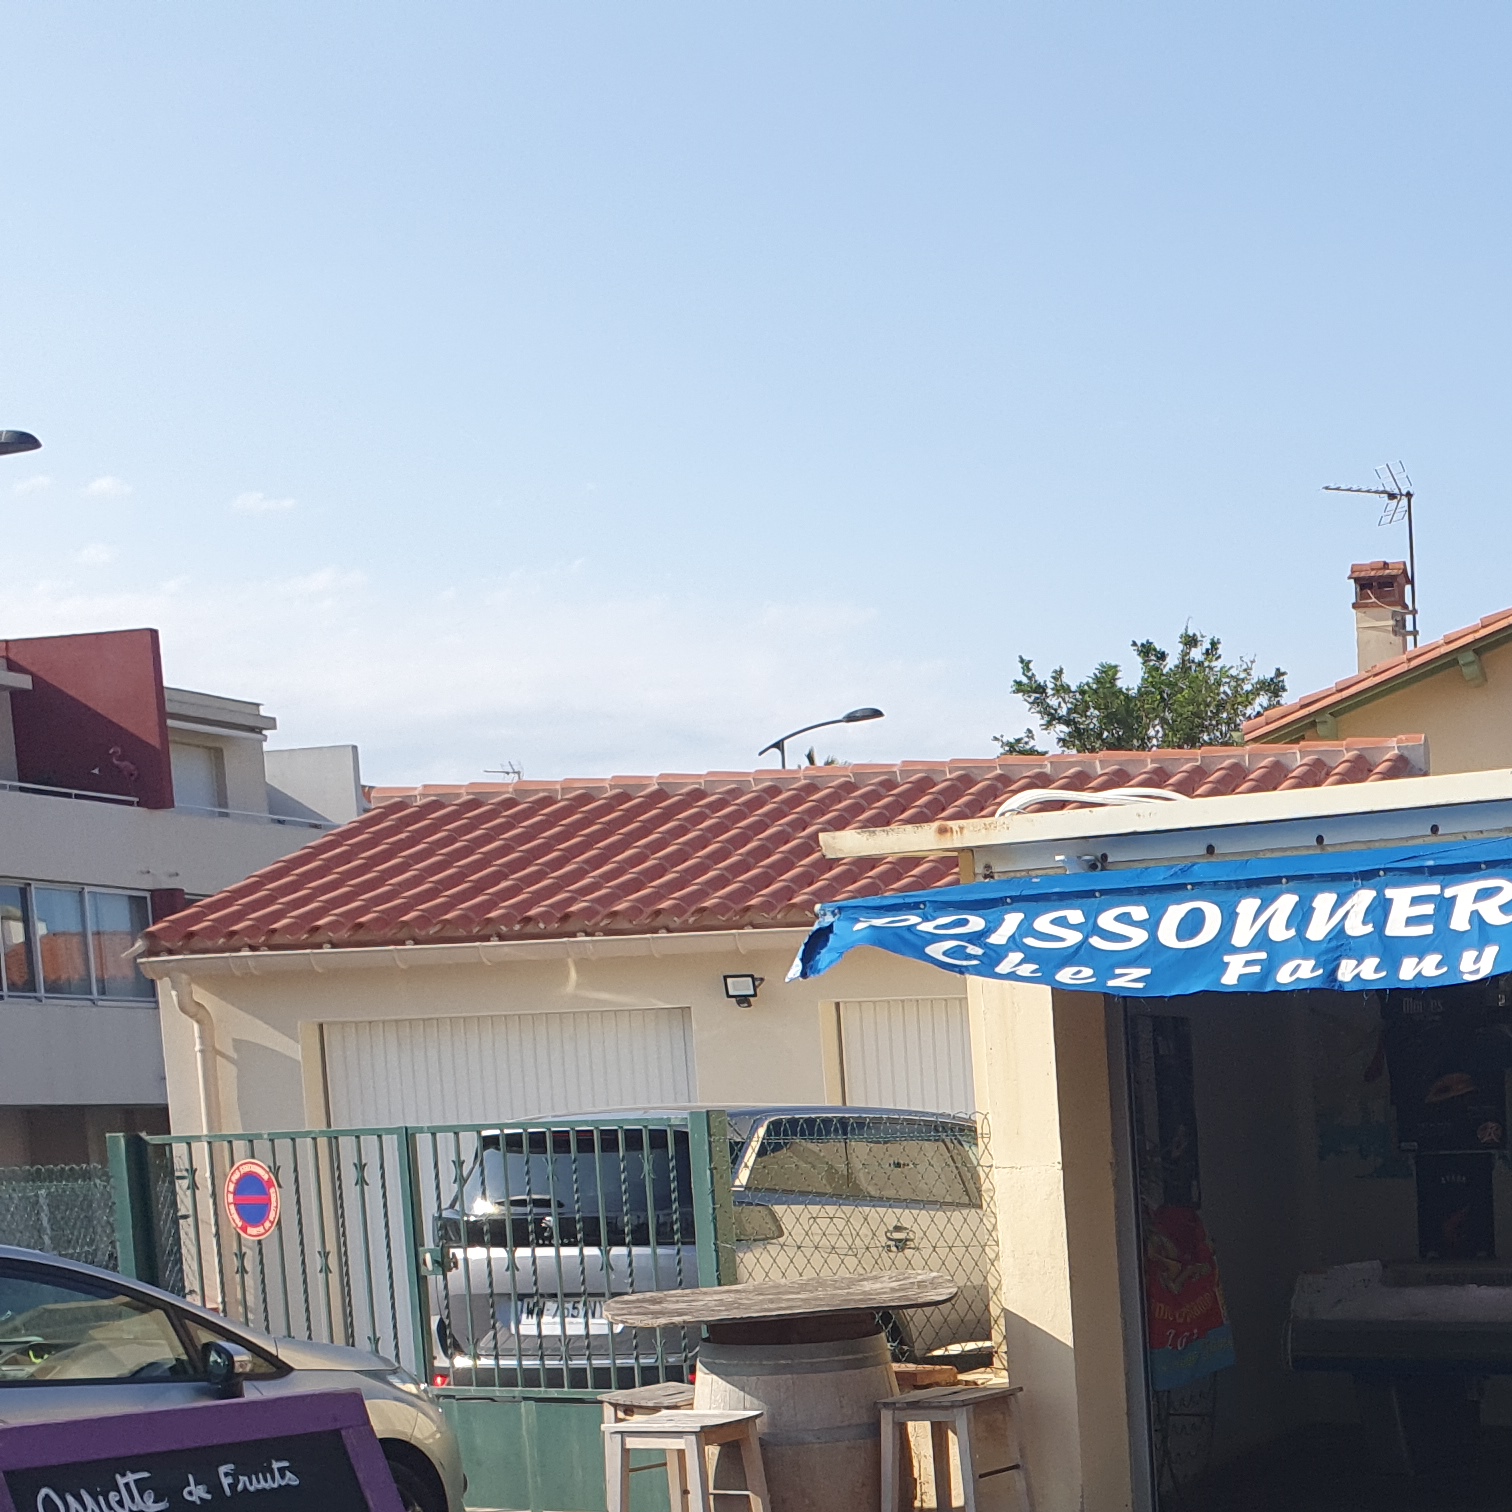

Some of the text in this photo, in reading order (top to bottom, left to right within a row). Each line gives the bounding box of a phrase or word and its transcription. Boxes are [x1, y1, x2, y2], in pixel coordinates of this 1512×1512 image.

[924, 940, 1499, 988] Chez Fanny
[182, 1473, 212, 1505] de
[217, 1459, 301, 1496] Fruits
